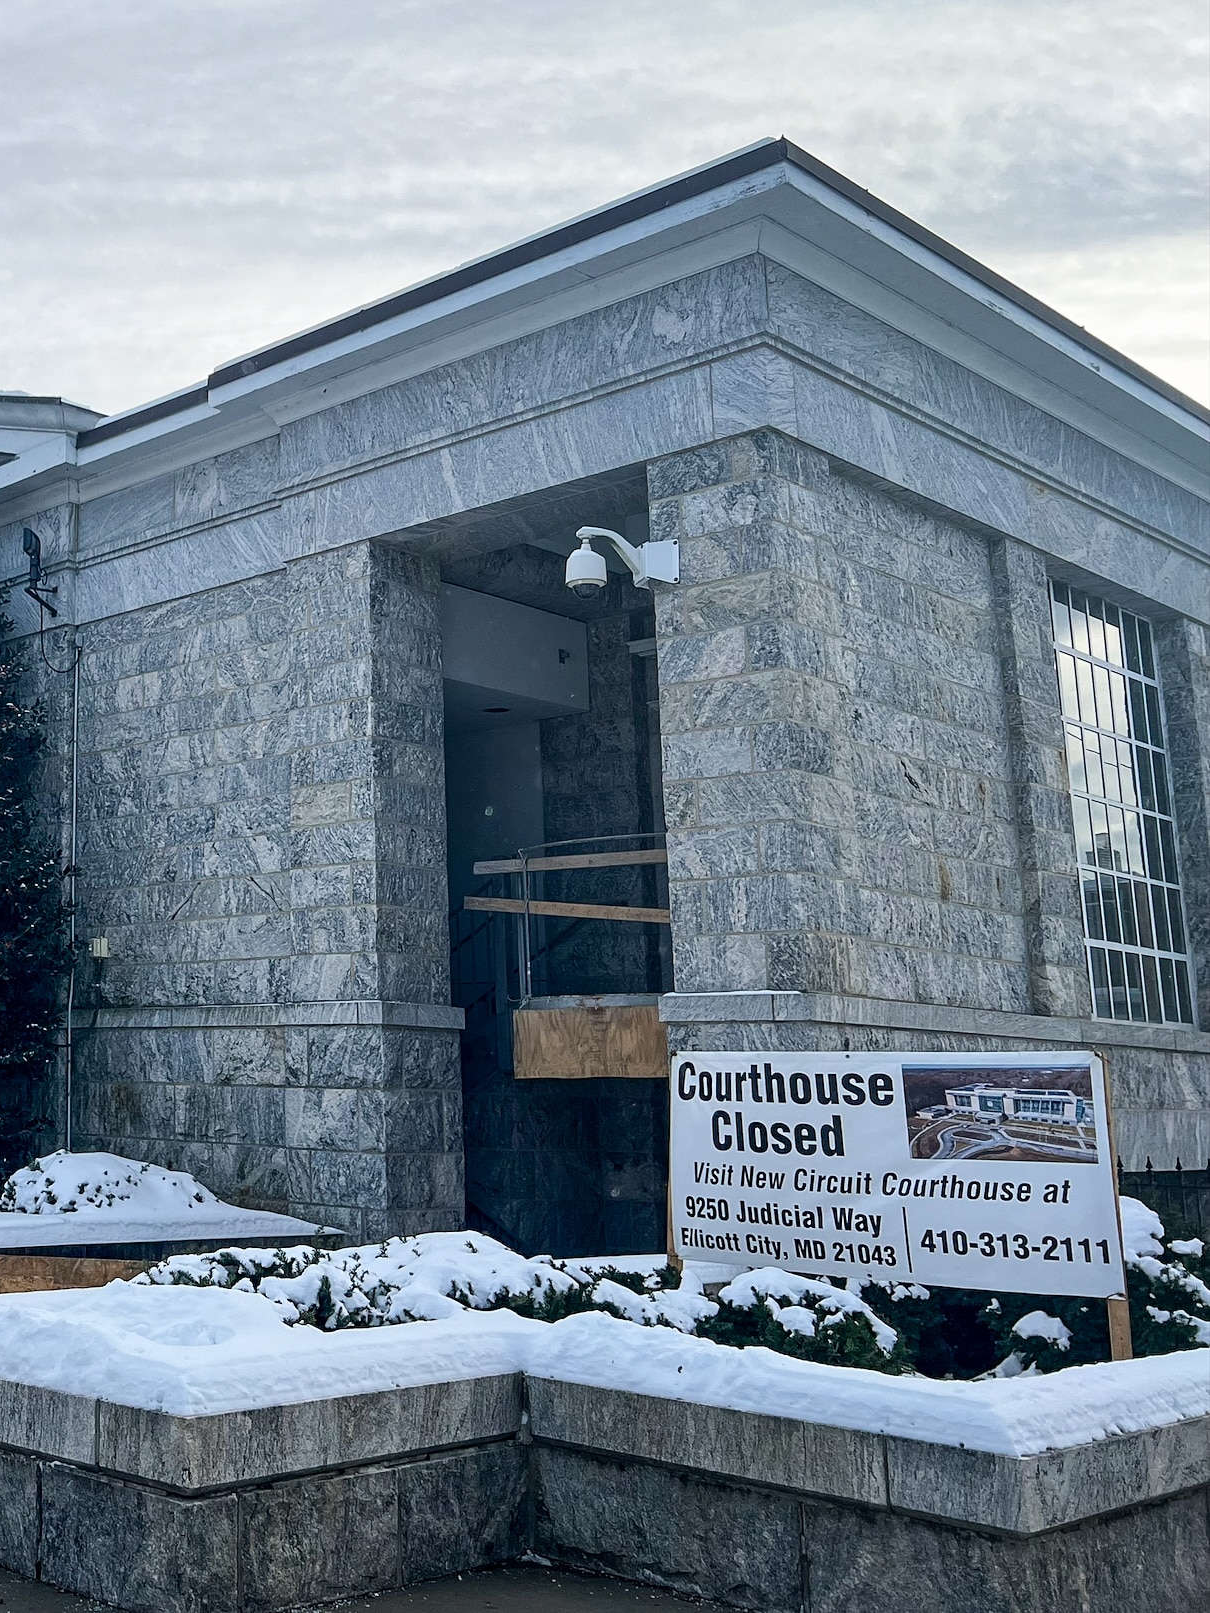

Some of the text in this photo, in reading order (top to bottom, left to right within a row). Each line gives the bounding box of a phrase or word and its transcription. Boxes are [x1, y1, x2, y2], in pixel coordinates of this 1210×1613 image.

[678, 1062, 894, 1106] Courthouse
[711, 1110, 845, 1156] Closed
[693, 1162, 1071, 1204] Visit New Circuit Courthouse at
[685, 1196, 882, 1238] 9250 Judicial Way
[680, 1227, 897, 1267] Ellicott City, MD 21043
[920, 1229, 1111, 1264] 410-313-2111
